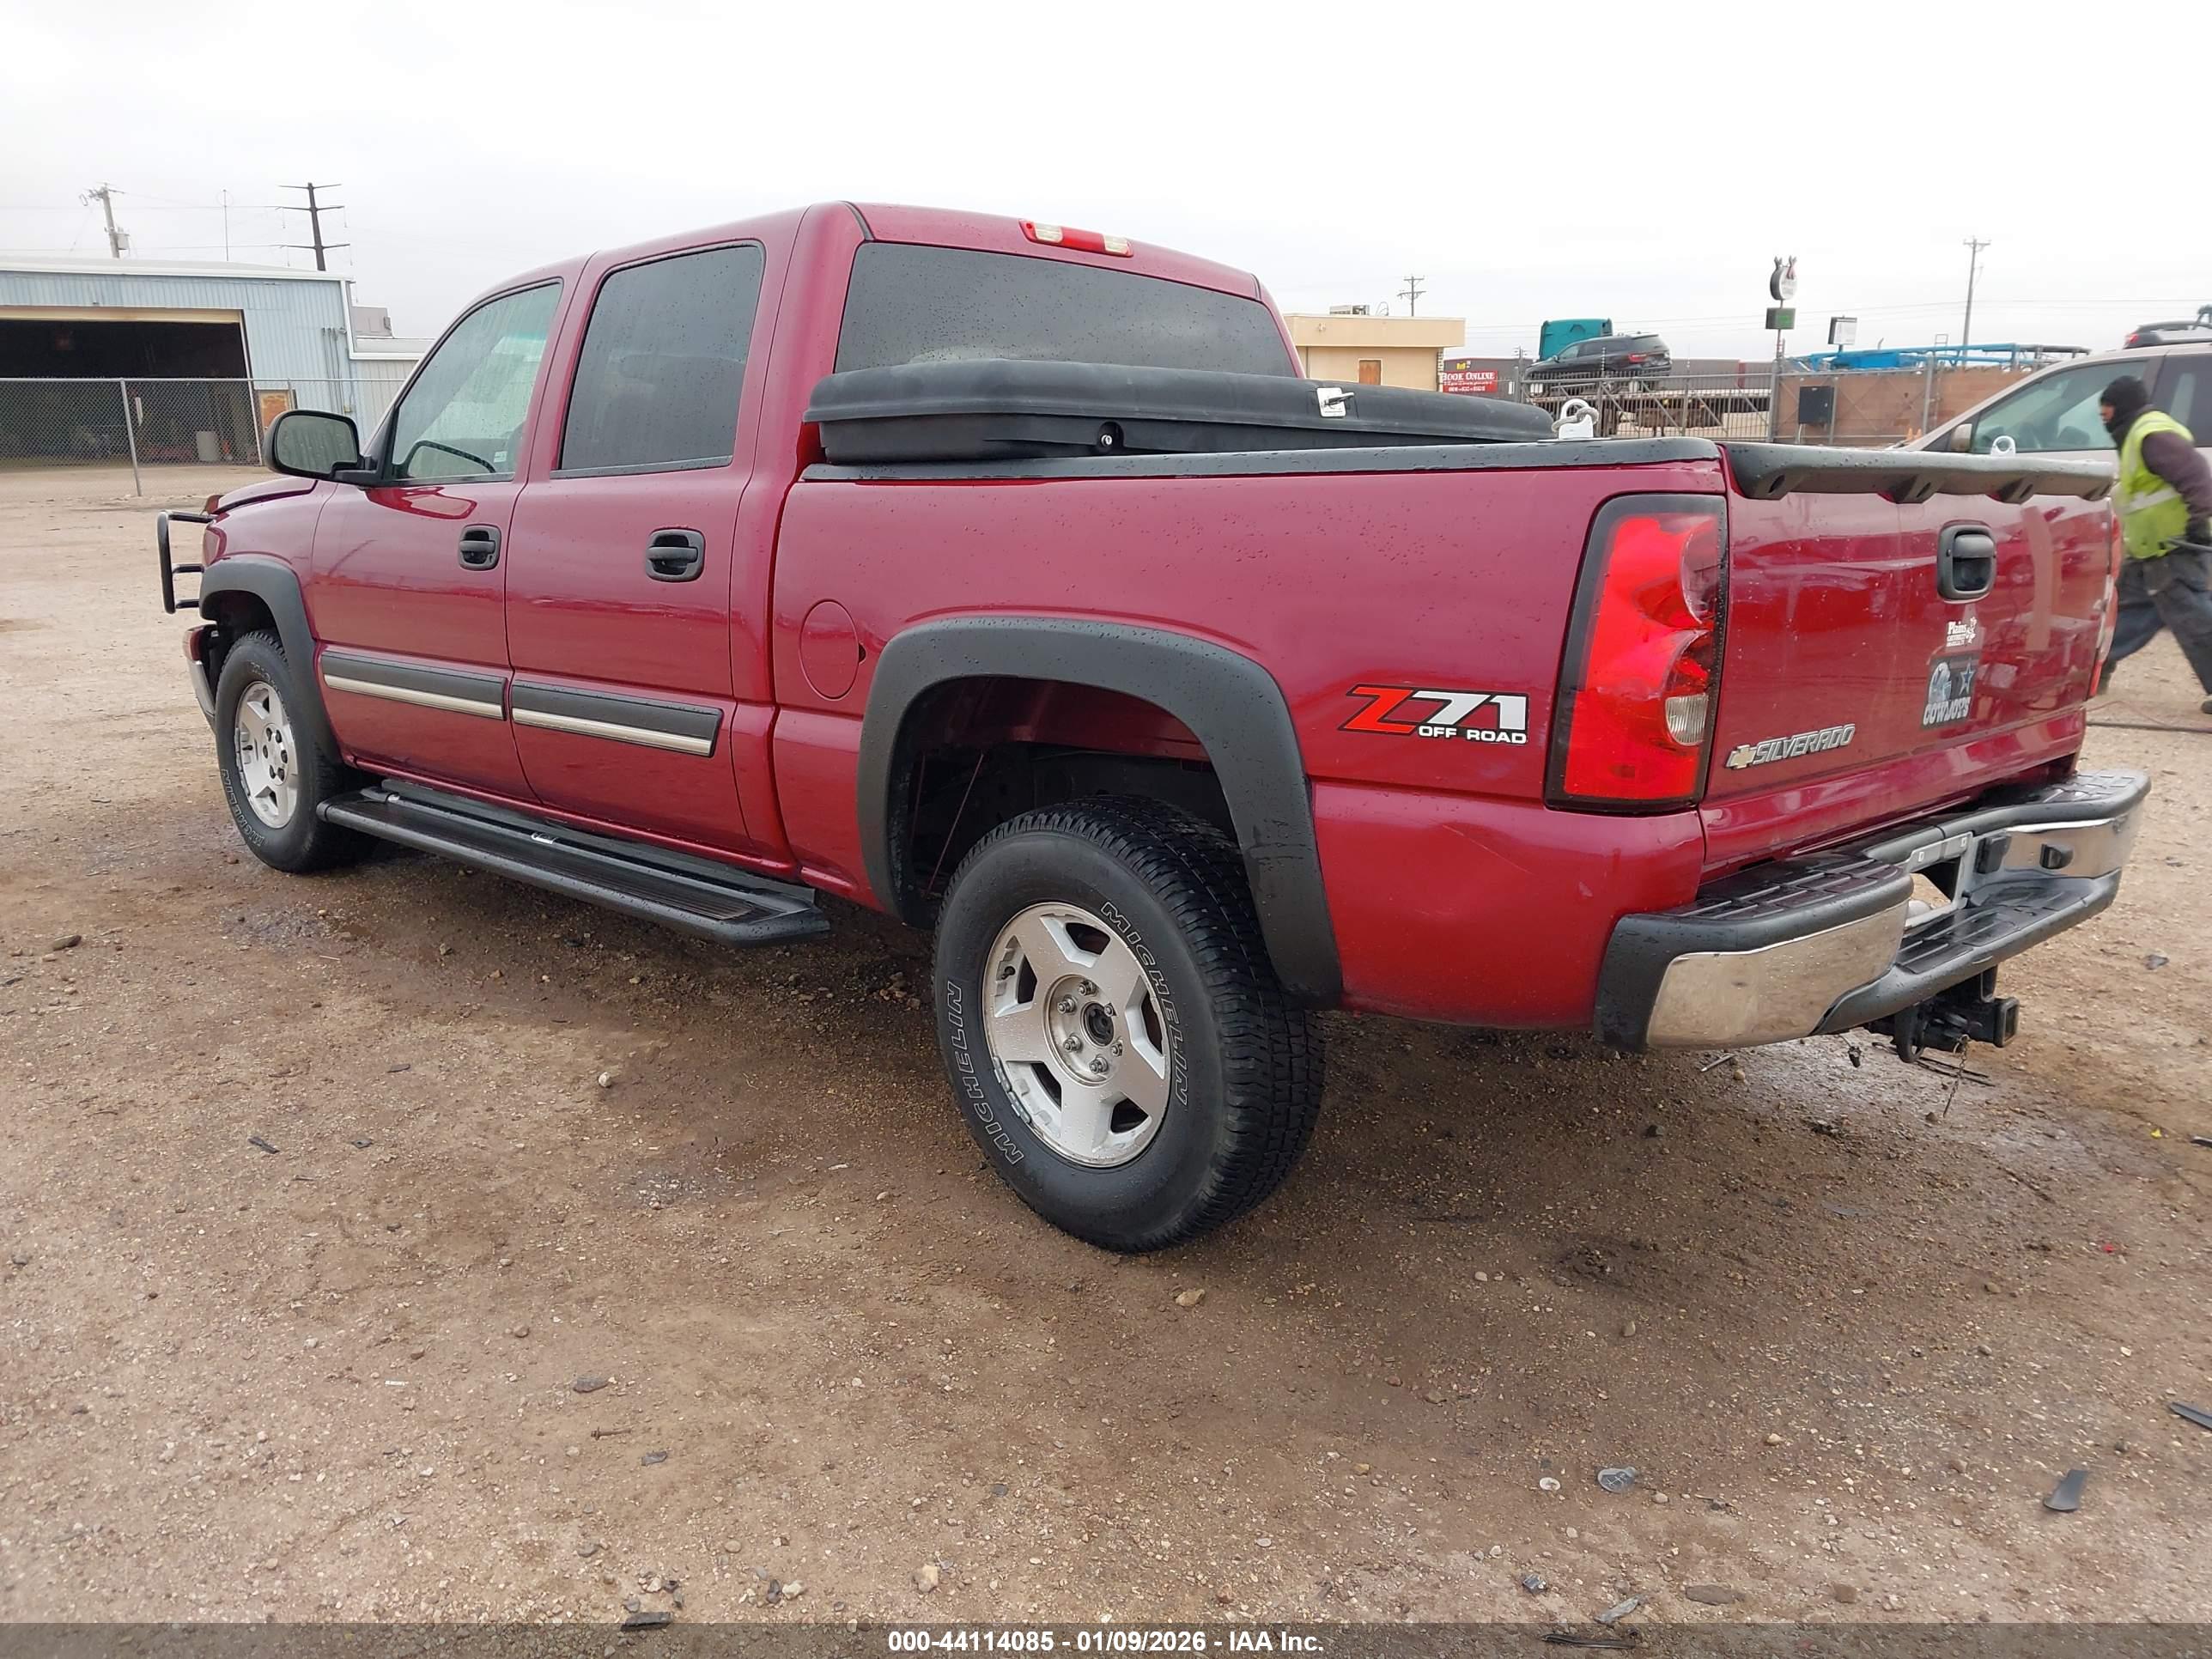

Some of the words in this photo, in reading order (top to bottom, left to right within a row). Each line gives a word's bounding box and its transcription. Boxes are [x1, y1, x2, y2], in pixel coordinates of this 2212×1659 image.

[1340, 685, 1528, 736] Z71
[1419, 726, 1456, 738] OFF
[1467, 729, 1527, 744] ROAD
[1753, 724, 1856, 764] SILVERADO
[221, 769, 265, 847] MICHELIN
[1101, 902, 1188, 1105] MICHELIN
[945, 980, 1024, 1164] MICHELIN
